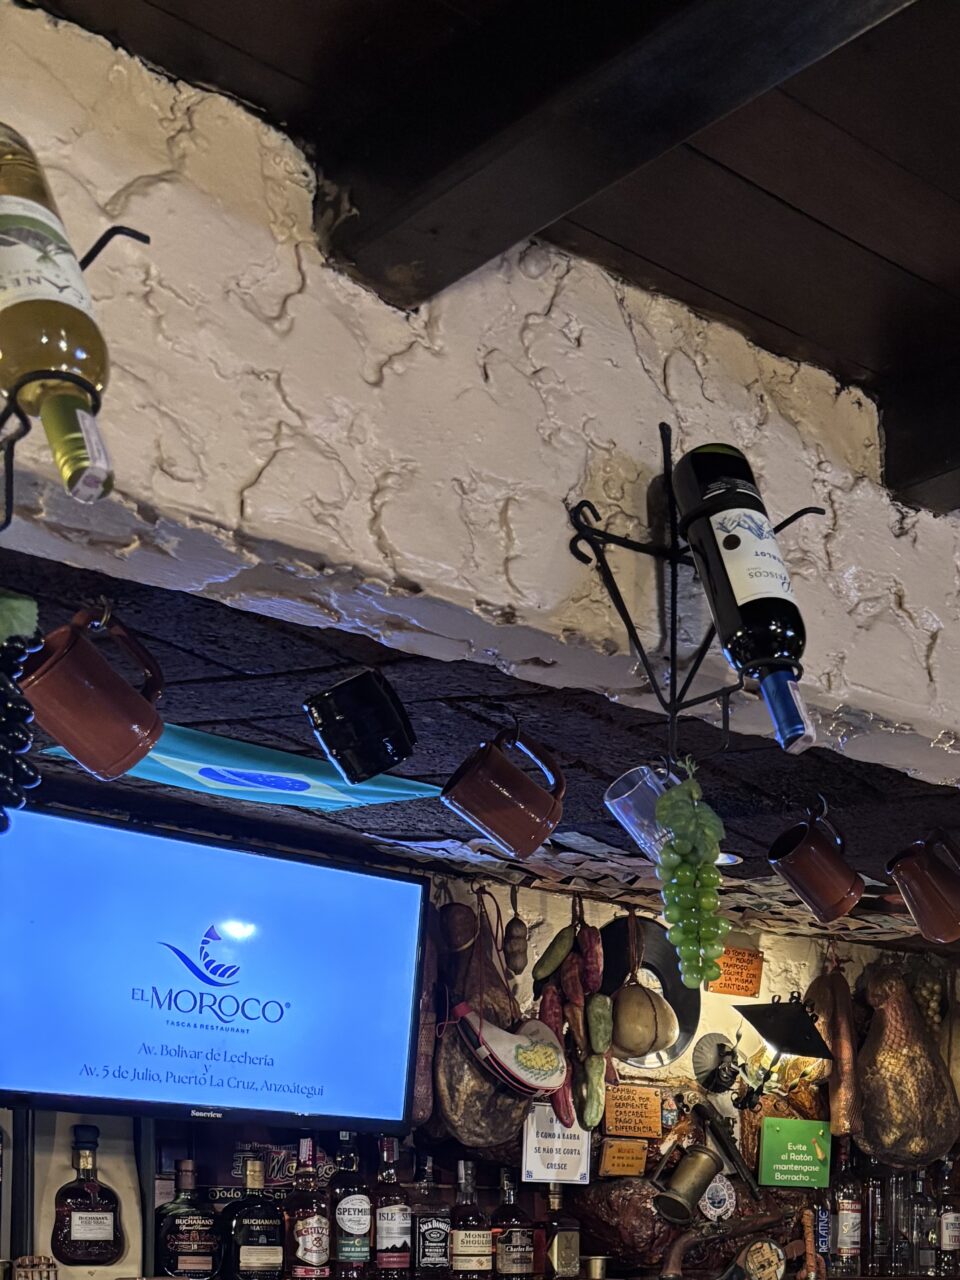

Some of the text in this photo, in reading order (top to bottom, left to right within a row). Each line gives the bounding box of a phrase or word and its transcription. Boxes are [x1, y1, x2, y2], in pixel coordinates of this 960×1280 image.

[722, 969, 744, 978] EGUIRE
[131, 987, 149, 1002] EL
[166, 1019, 191, 1028] TASCA
[199, 1023, 250, 1034] RESTAURANT
[138, 1042, 157, 1056] Av.
[205, 1047, 221, 1061] de
[223, 1050, 274, 1067] Lechería
[79, 1063, 324, 1099] Av. 5 de Julio, Puerto La Cruz, Anzoátegui
[611, 1087, 637, 1095] CAMBIO
[614, 1102, 649, 1110] SERPIENTE
[790, 1152, 813, 1161] Ratón
[546, 1162, 568, 1170] CRESCE
[773, 1163, 820, 1172] mantengase
[774, 1172, 810, 1181] Borracho
[209, 1187, 241, 1200] Todo
[379, 1212, 396, 1221] ISLE
